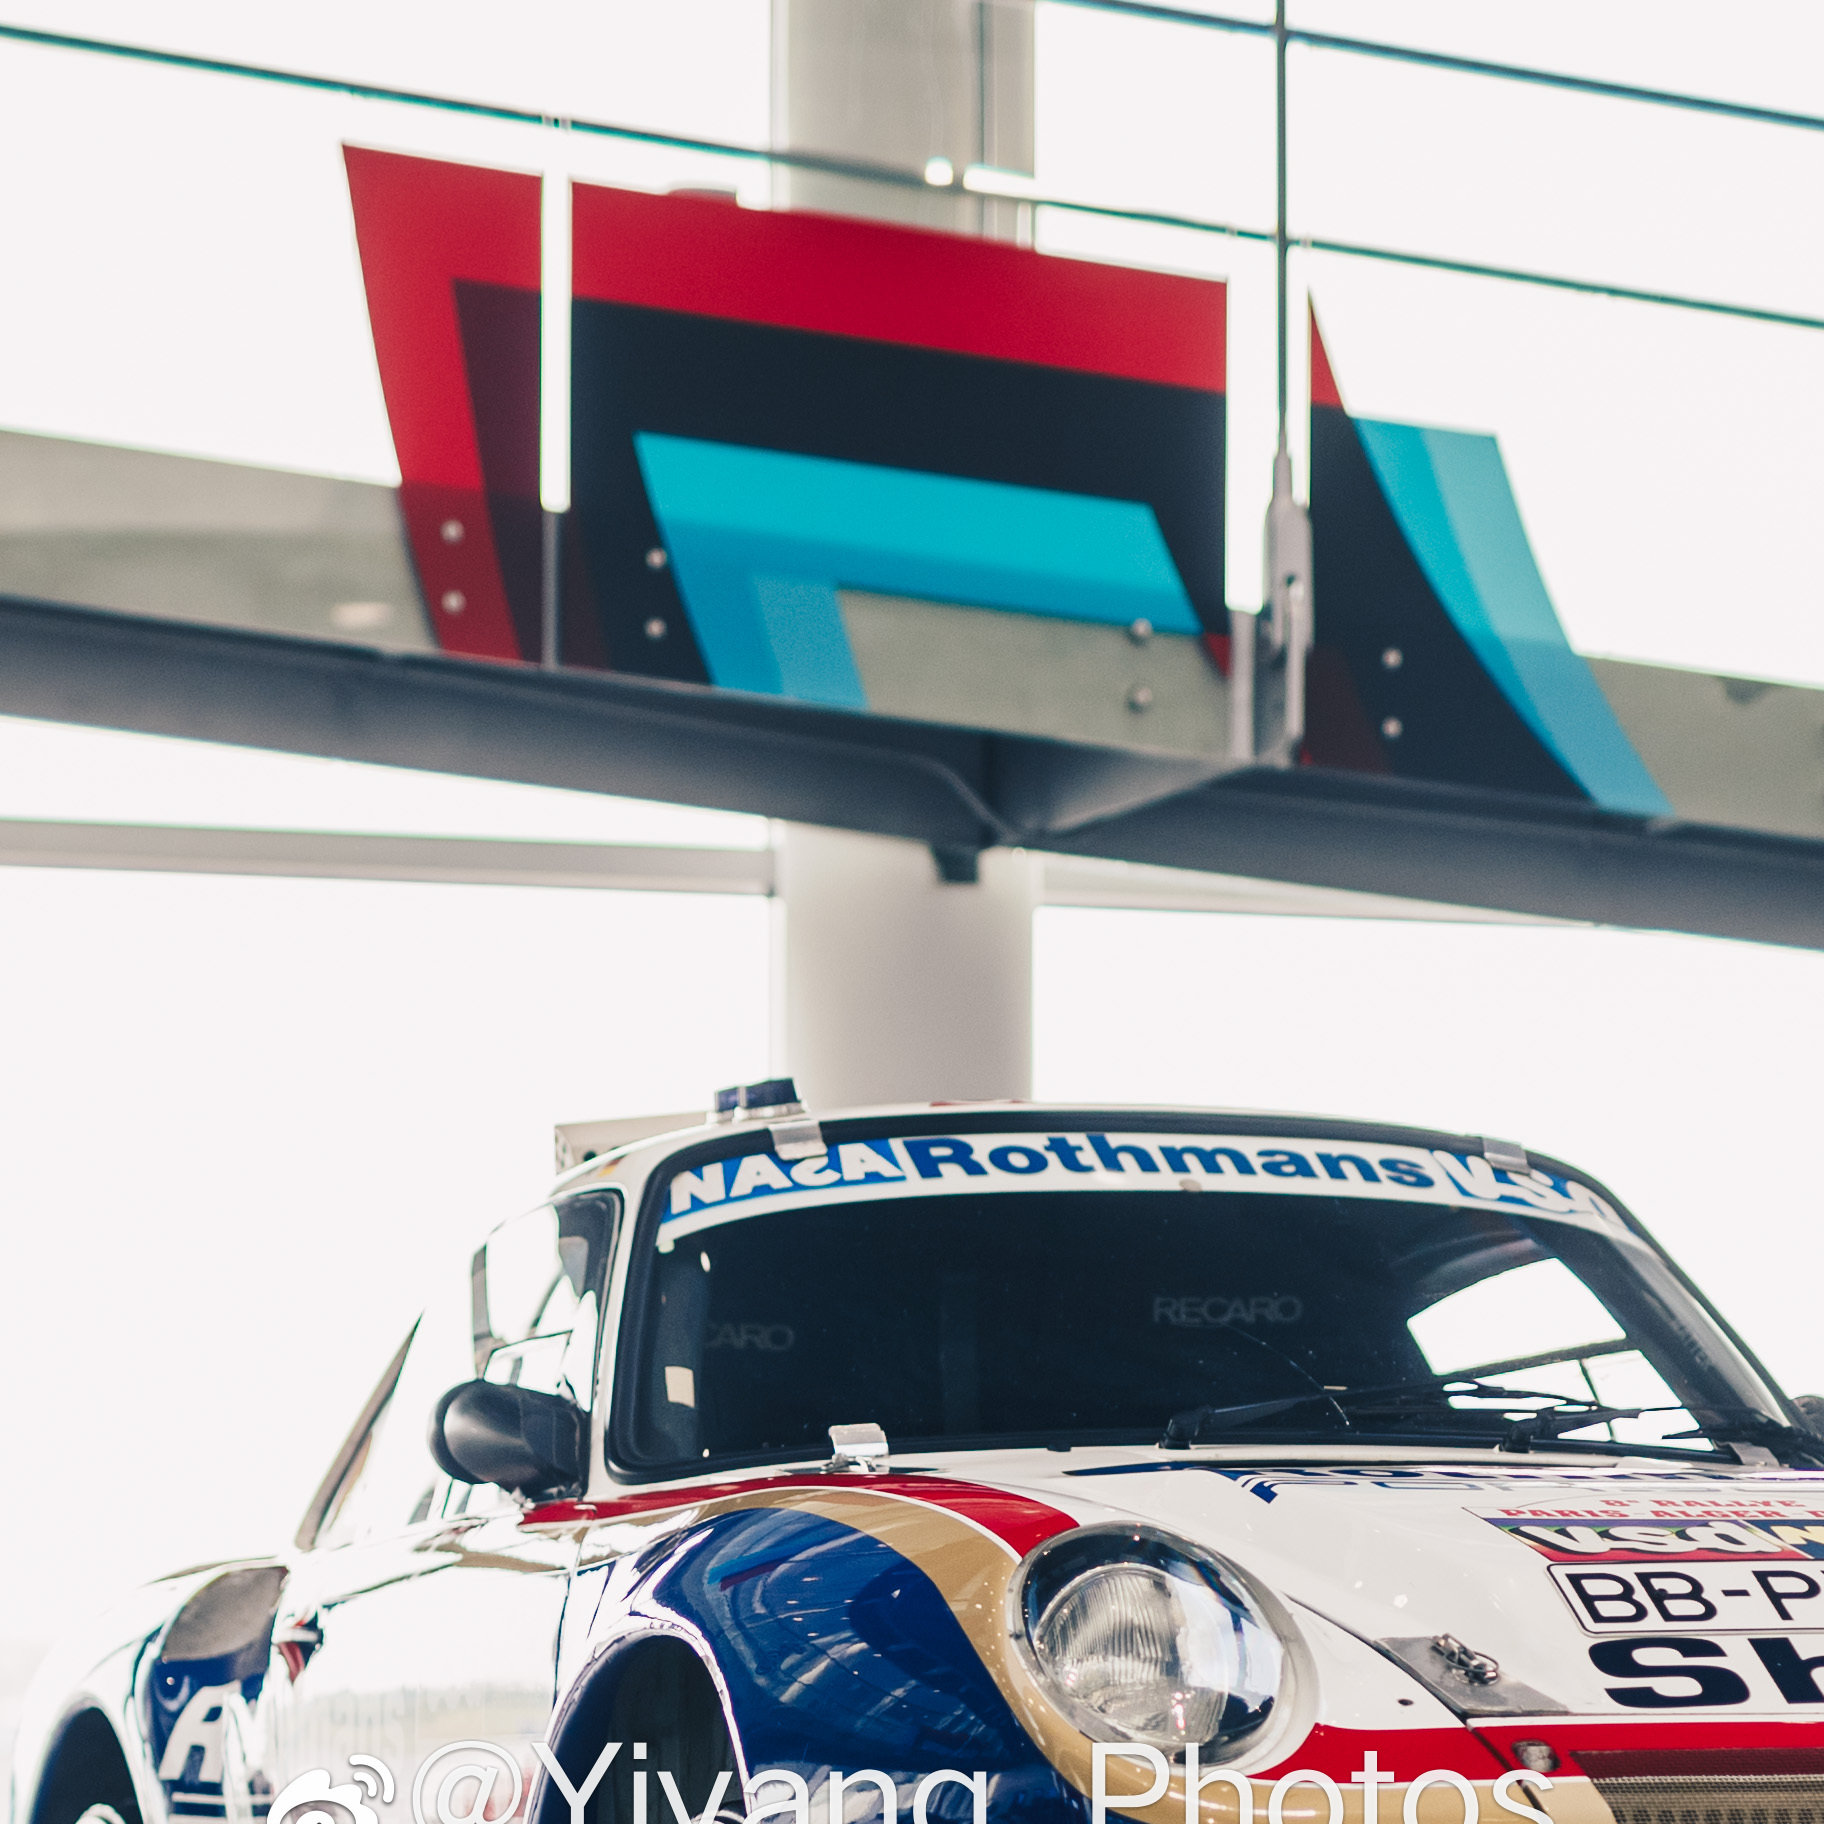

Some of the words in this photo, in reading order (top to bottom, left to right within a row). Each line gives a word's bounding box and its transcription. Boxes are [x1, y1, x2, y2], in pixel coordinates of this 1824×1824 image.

[902, 1132, 1435, 1188] Rothmans
[1153, 1296, 1303, 1327] RECARO
[1498, 1508, 1629, 1518] PARIS
[1650, 1509, 1788, 1518] ALGER
[1650, 1499, 1805, 1508] RALLYE
